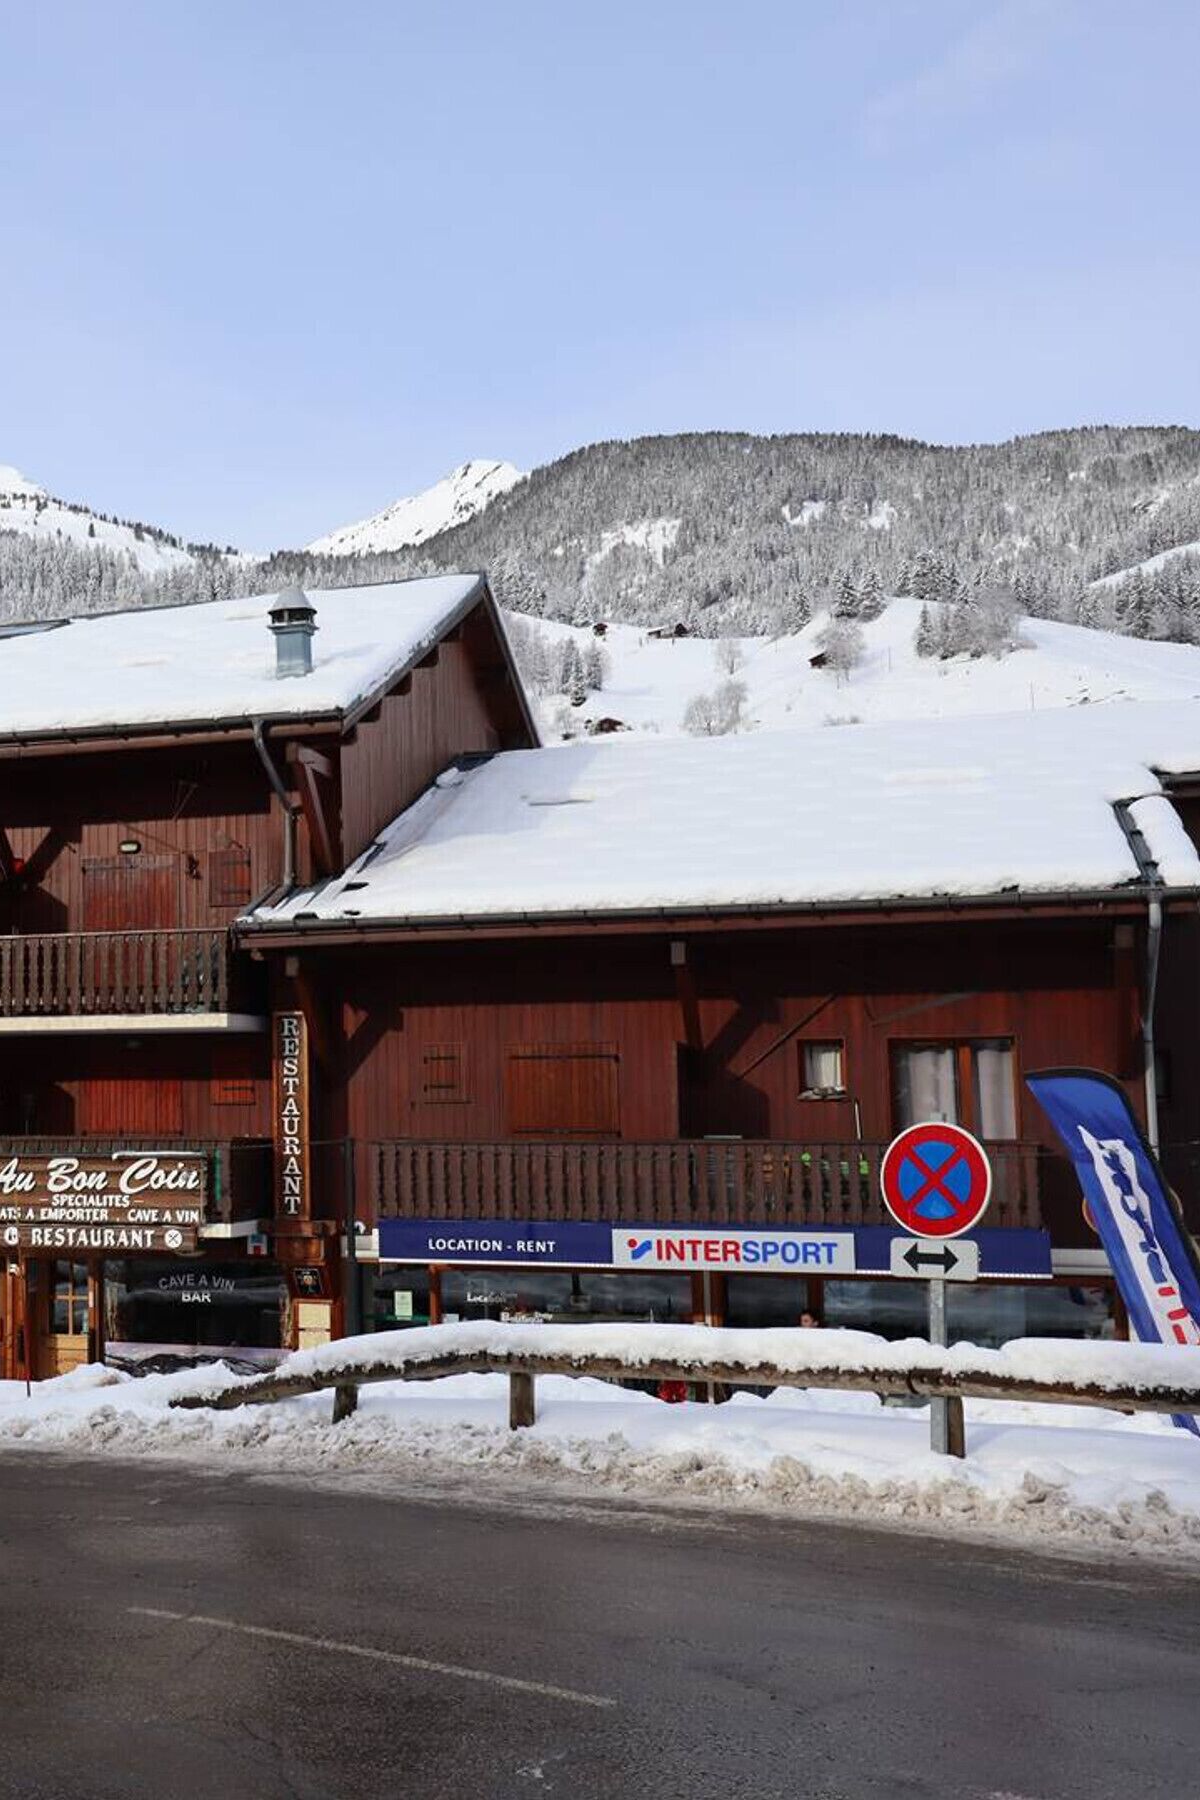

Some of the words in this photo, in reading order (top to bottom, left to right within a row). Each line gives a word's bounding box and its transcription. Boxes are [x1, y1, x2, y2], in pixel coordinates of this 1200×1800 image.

[281, 1017, 303, 1215] RESTAURANT
[46, 1157, 108, 1194] Bon
[118, 1157, 200, 1195] Coin
[51, 1194, 131, 1208] SPECIALITES
[25, 1208, 35, 1221] A
[39, 1208, 109, 1222] EMPORTER
[126, 1208, 159, 1223] CAVE
[162, 1209, 172, 1223] A
[176, 1209, 200, 1223] VIN
[30, 1227, 156, 1249] RESTAURANT
[427, 1237, 503, 1252] LOCATION
[516, 1239, 557, 1253] RENT
[655, 1237, 839, 1265] INTERSPORT
[158, 1272, 195, 1290] CAVE
[211, 1275, 236, 1293] VIN
[181, 1289, 212, 1304] BAR
